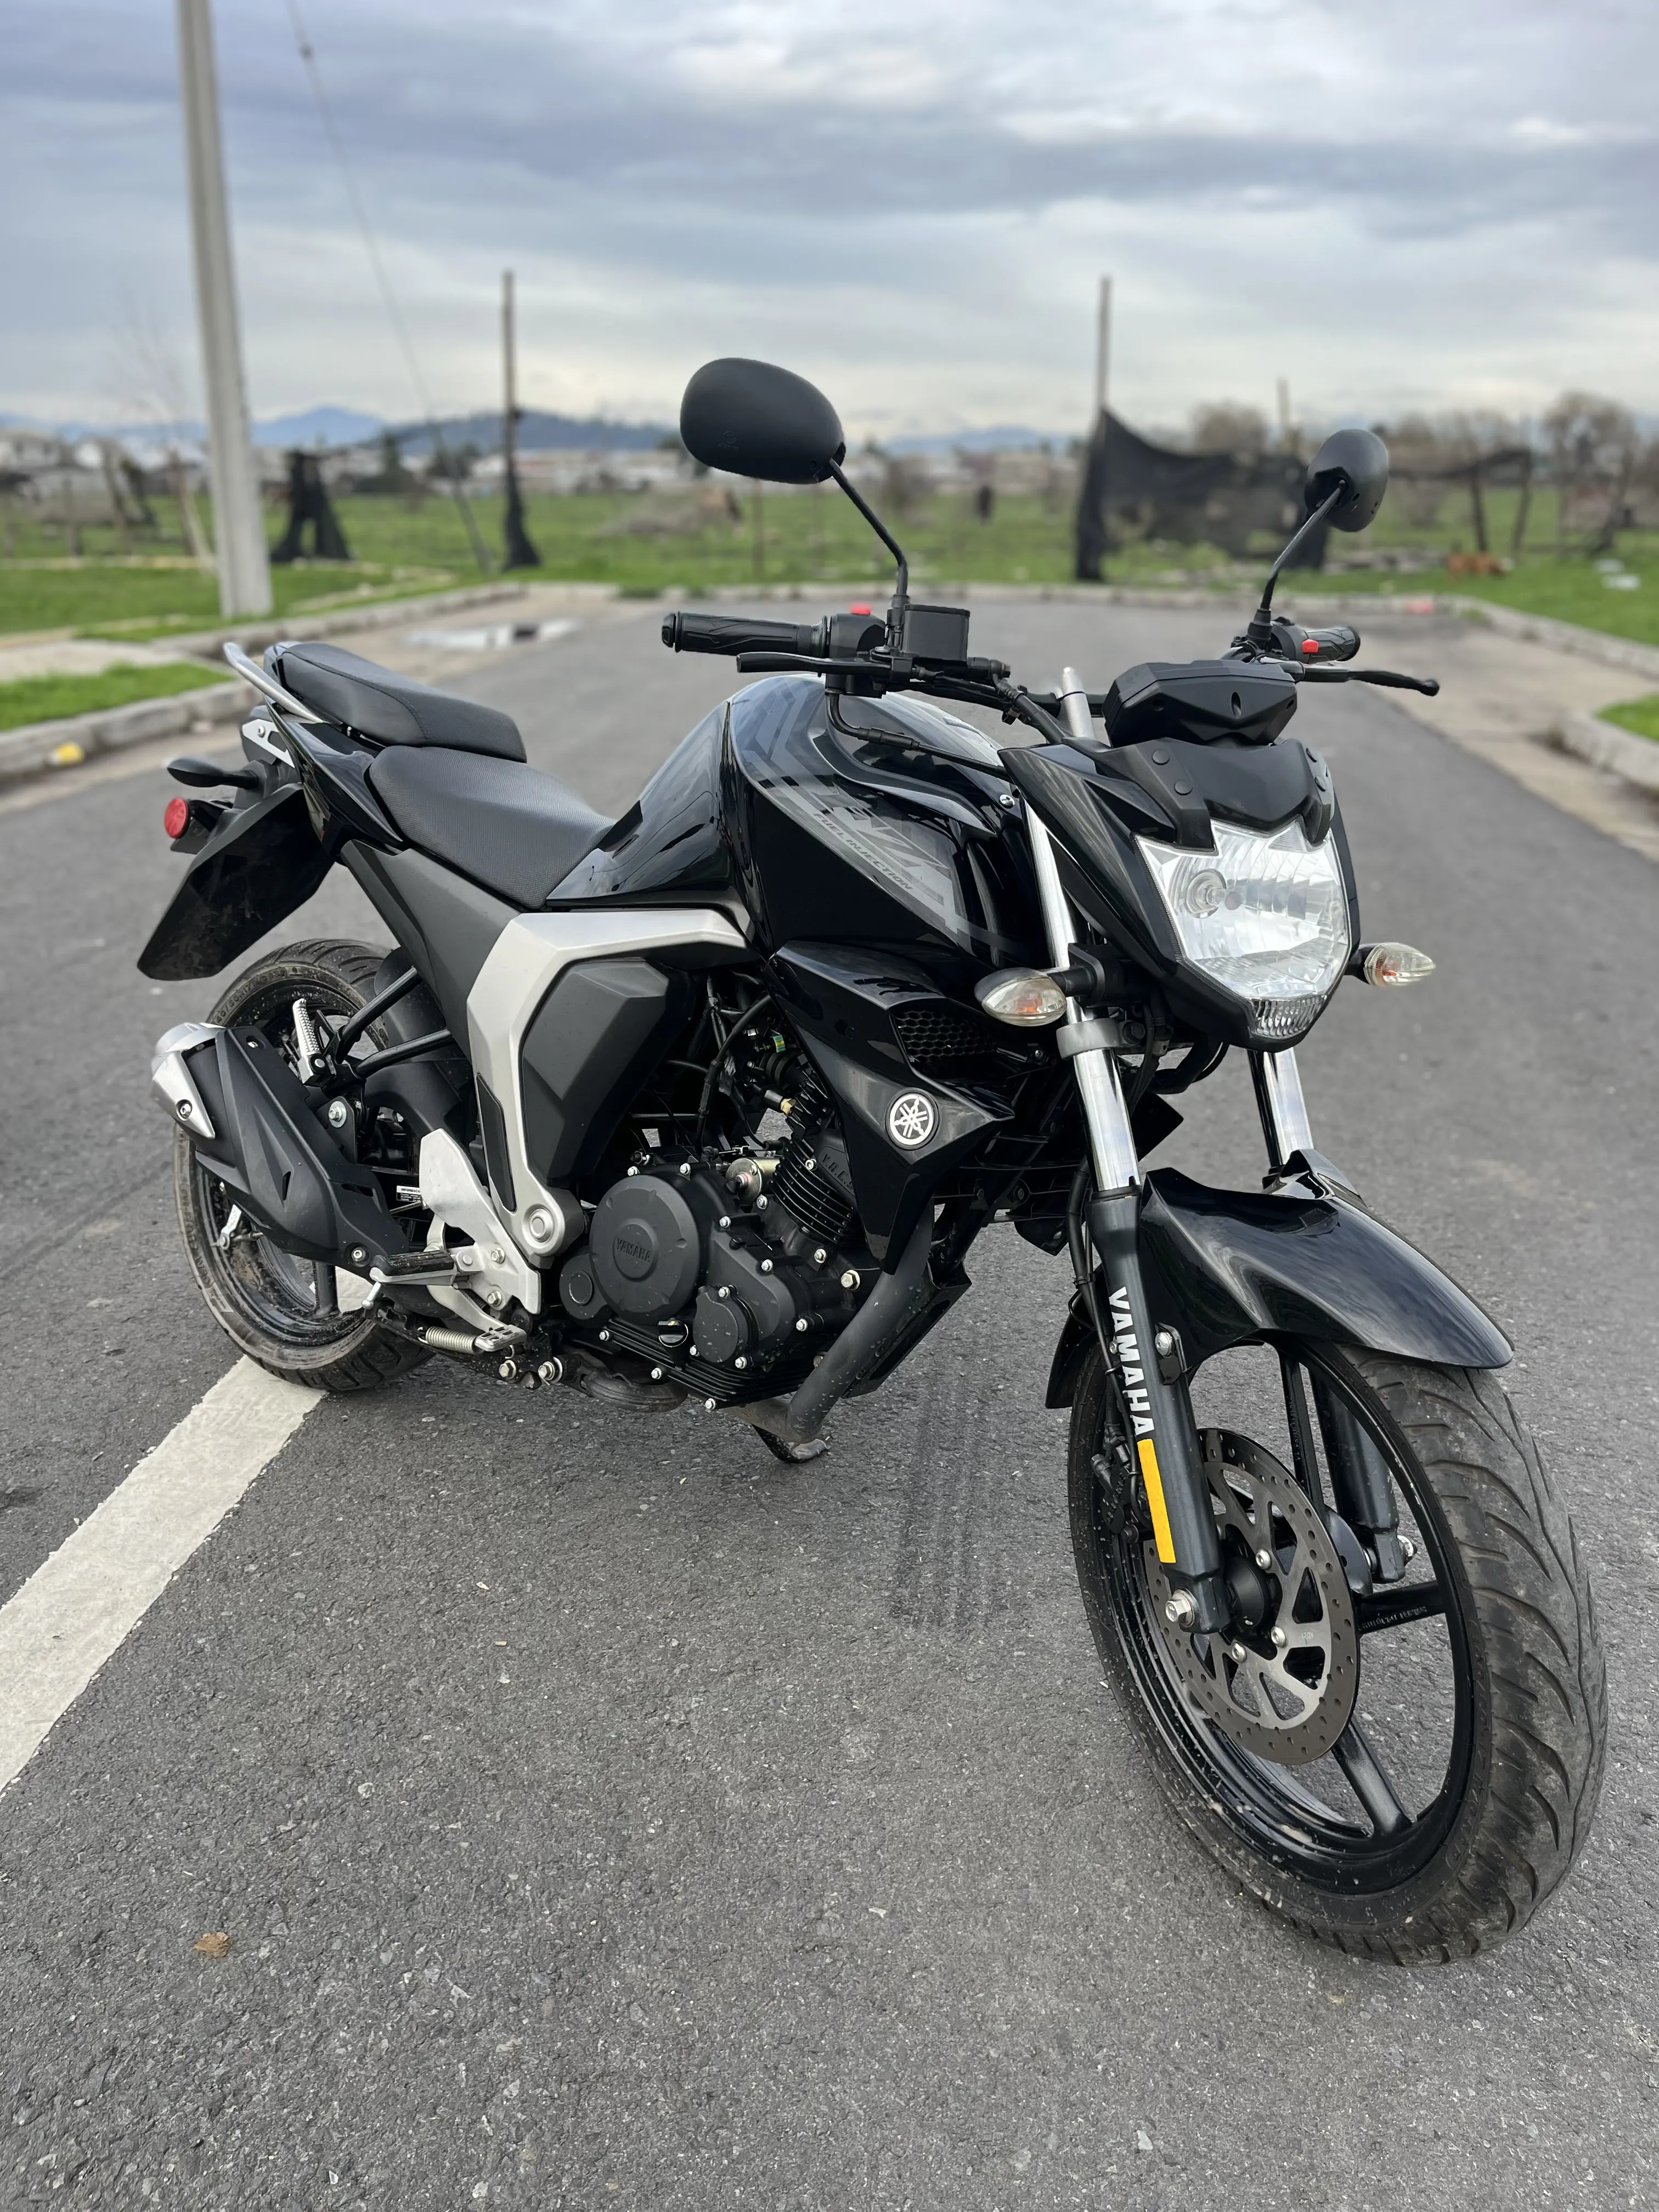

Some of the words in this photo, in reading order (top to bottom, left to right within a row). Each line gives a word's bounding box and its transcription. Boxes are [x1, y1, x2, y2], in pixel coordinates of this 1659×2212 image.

[812, 812, 846, 840] FUEL
[845, 839, 913, 890] INJECTION
[617, 1238, 652, 1263] YAMAHA
[1108, 1286, 1155, 1436] YAMAHA
